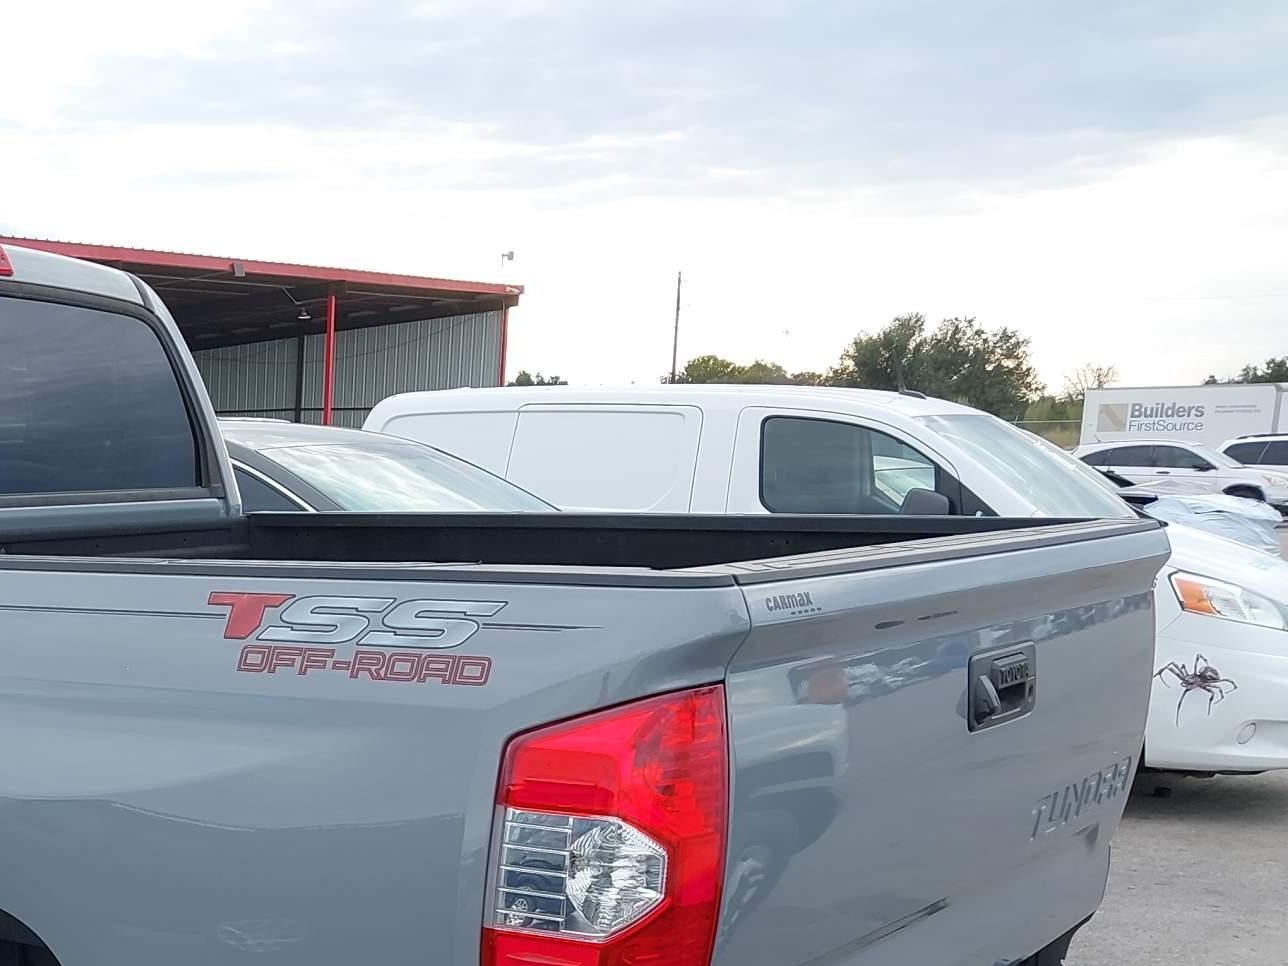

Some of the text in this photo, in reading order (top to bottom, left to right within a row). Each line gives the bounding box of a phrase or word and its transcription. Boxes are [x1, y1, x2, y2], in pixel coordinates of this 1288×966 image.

[1128, 419, 1203, 432] FirstSource
[1130, 403, 1205, 419] Builders
[208, 591, 508, 649] TSS
[236, 644, 492, 686] OFF-ROAD
